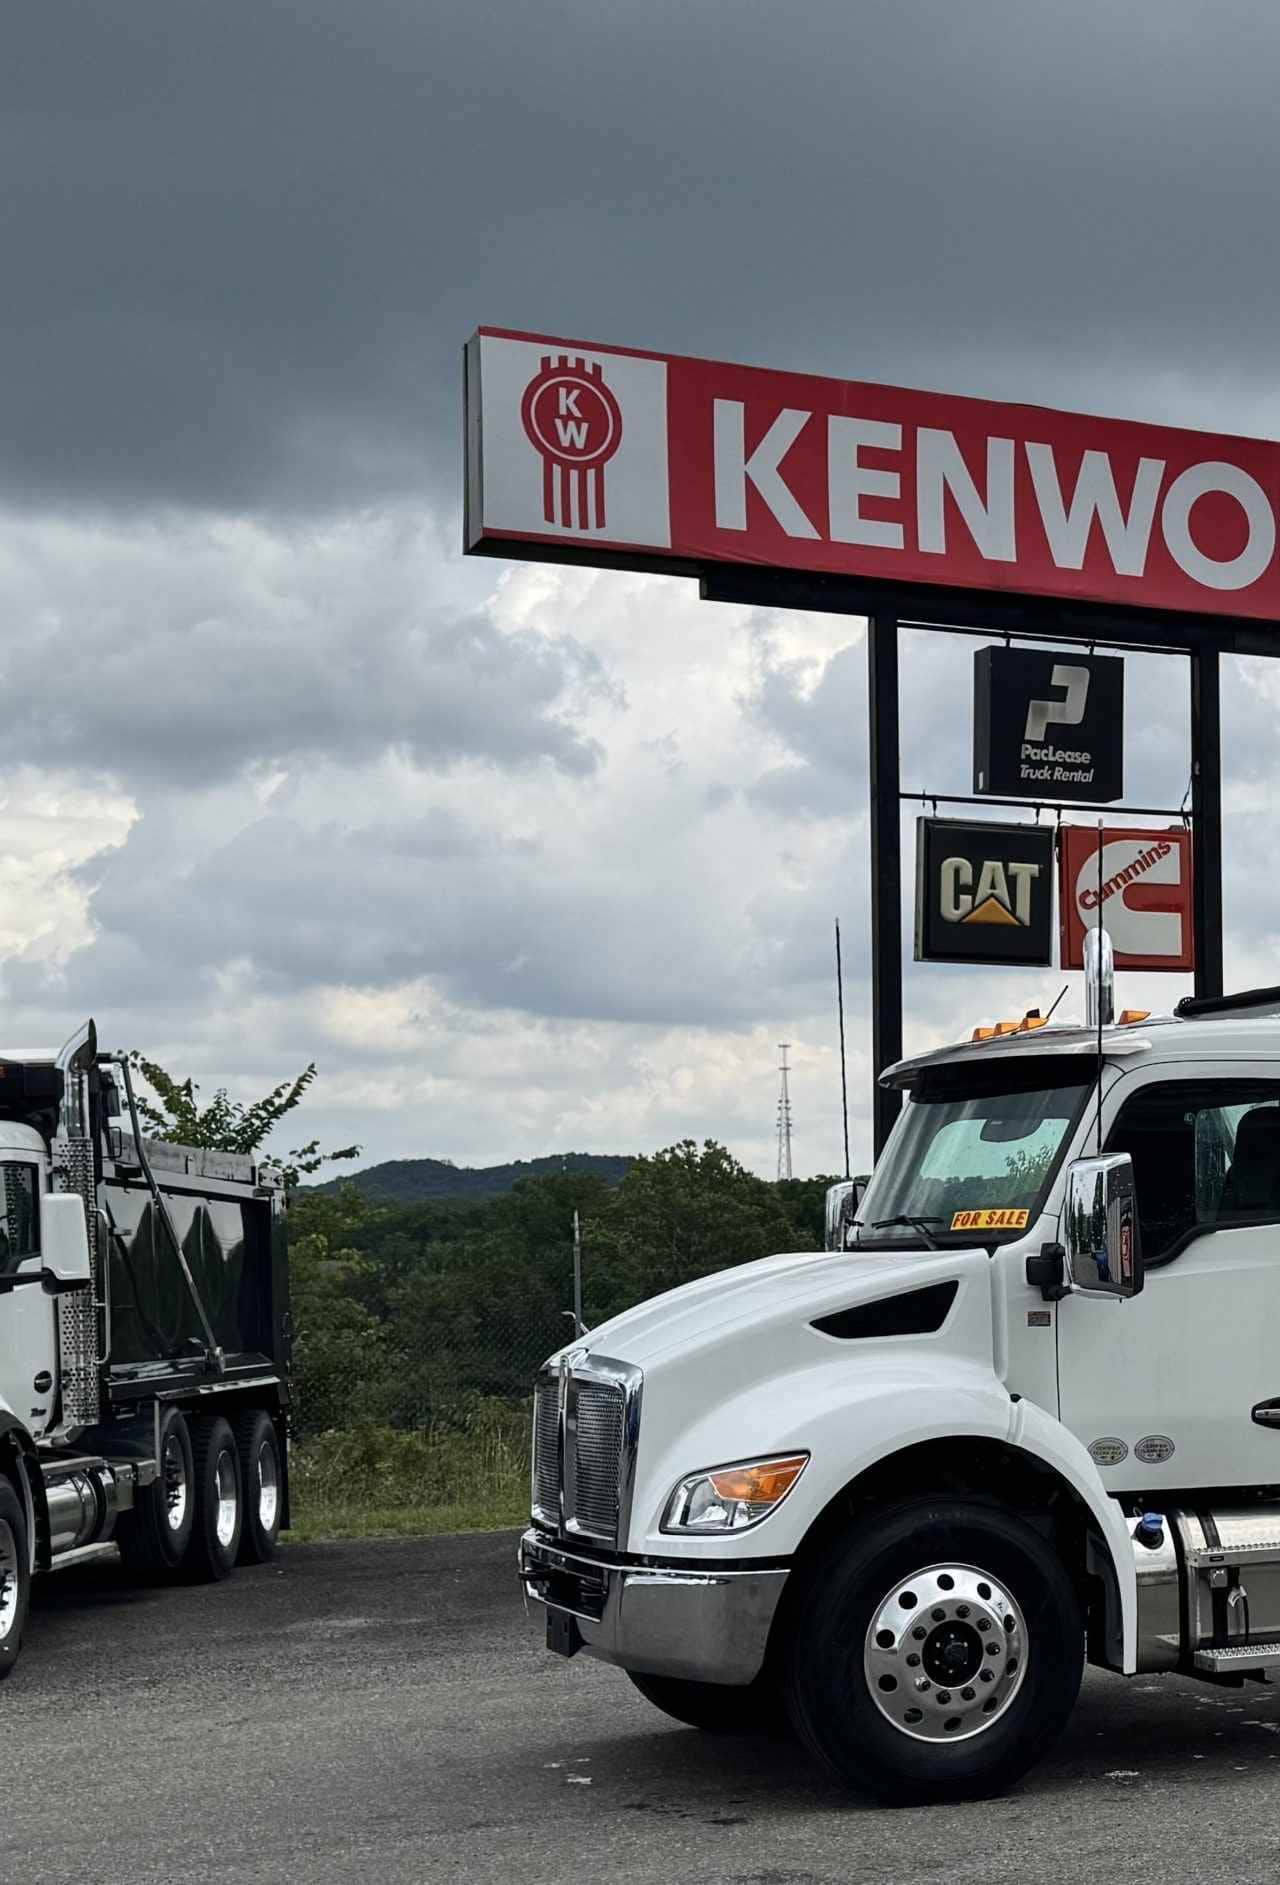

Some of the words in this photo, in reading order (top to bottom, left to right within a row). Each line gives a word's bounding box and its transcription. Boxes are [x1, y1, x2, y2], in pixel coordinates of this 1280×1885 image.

[559, 387, 582, 418] K
[554, 418, 589, 449] W
[1020, 743, 1092, 764] PacLease
[1020, 764, 1051, 780] Truck
[1053, 766, 1095, 783] Rental
[1079, 841, 1172, 910] Cummins
[941, 857, 1039, 926] CAT
[953, 1212, 982, 1228] FOR
[985, 1210, 1028, 1226] SALE
